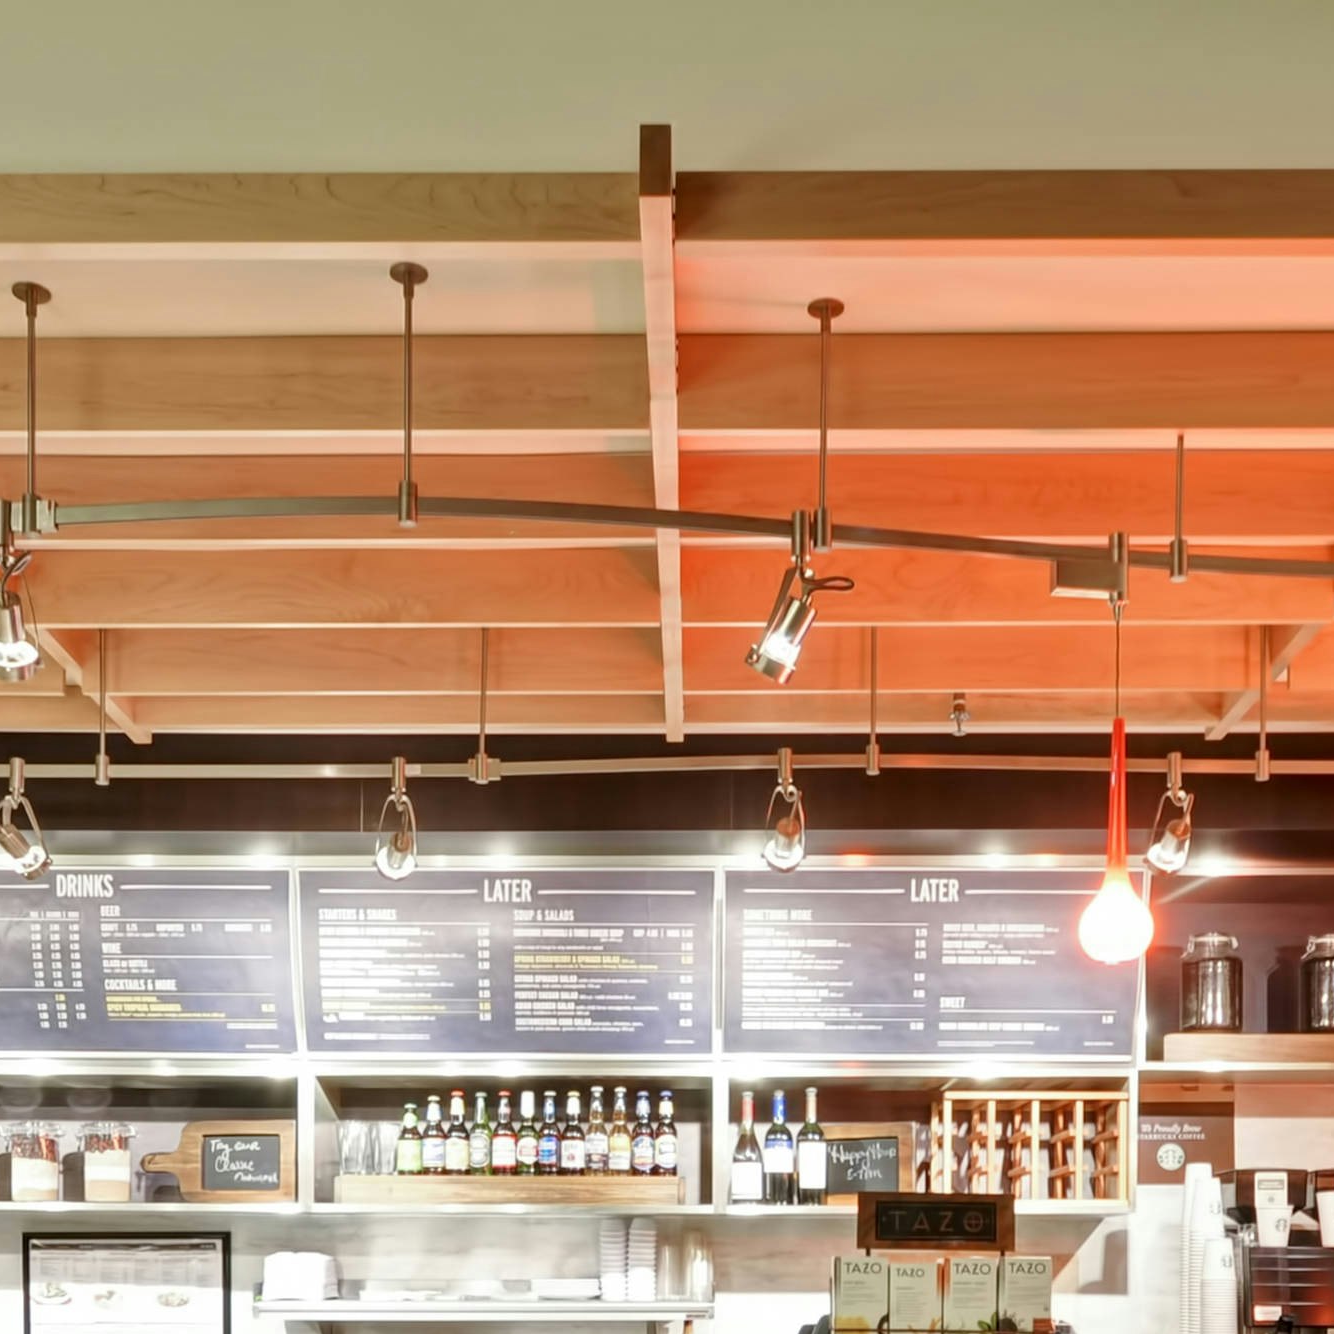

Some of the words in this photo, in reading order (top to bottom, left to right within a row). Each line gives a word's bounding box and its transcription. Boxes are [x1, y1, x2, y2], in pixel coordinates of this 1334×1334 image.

[56, 873, 114, 898] DRINKS
[483, 879, 532, 902] LATER
[910, 878, 960, 902] LATER
[888, 1210, 984, 1233] TAZO
[843, 1262, 883, 1275] TAZO
[896, 1267, 925, 1278] TAZO
[954, 1262, 992, 1276] TAZO
[1009, 1262, 1047, 1275] TAZO
